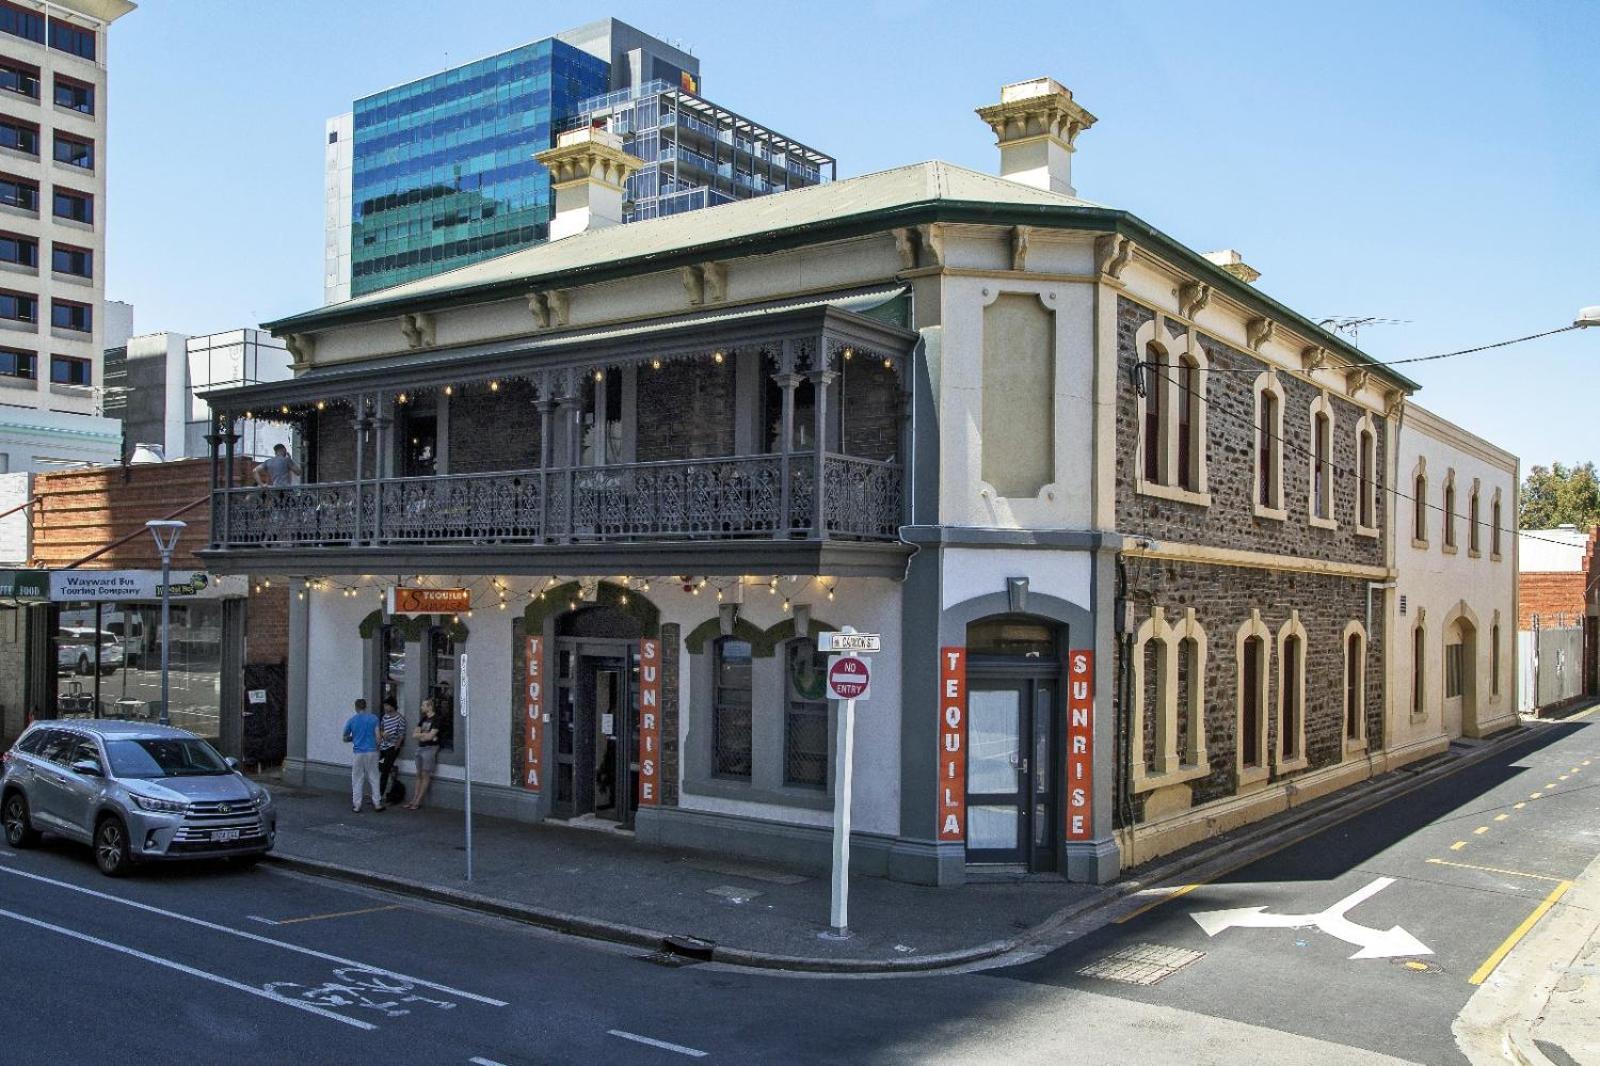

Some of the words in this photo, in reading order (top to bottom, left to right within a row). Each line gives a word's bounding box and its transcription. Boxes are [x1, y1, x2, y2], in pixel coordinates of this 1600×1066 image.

[60, 587, 96, 595] Touring
[98, 586, 141, 595] Company
[67, 577, 116, 586] Wayward
[119, 577, 134, 585] Bus
[837, 684, 861, 694] ENTRY
[844, 662, 857, 672] NO
[527, 639, 539, 786] TEQUILA
[643, 642, 656, 799] SUNRISE
[943, 652, 961, 834] TEQUILA
[1072, 655, 1088, 834] SUNRISE
